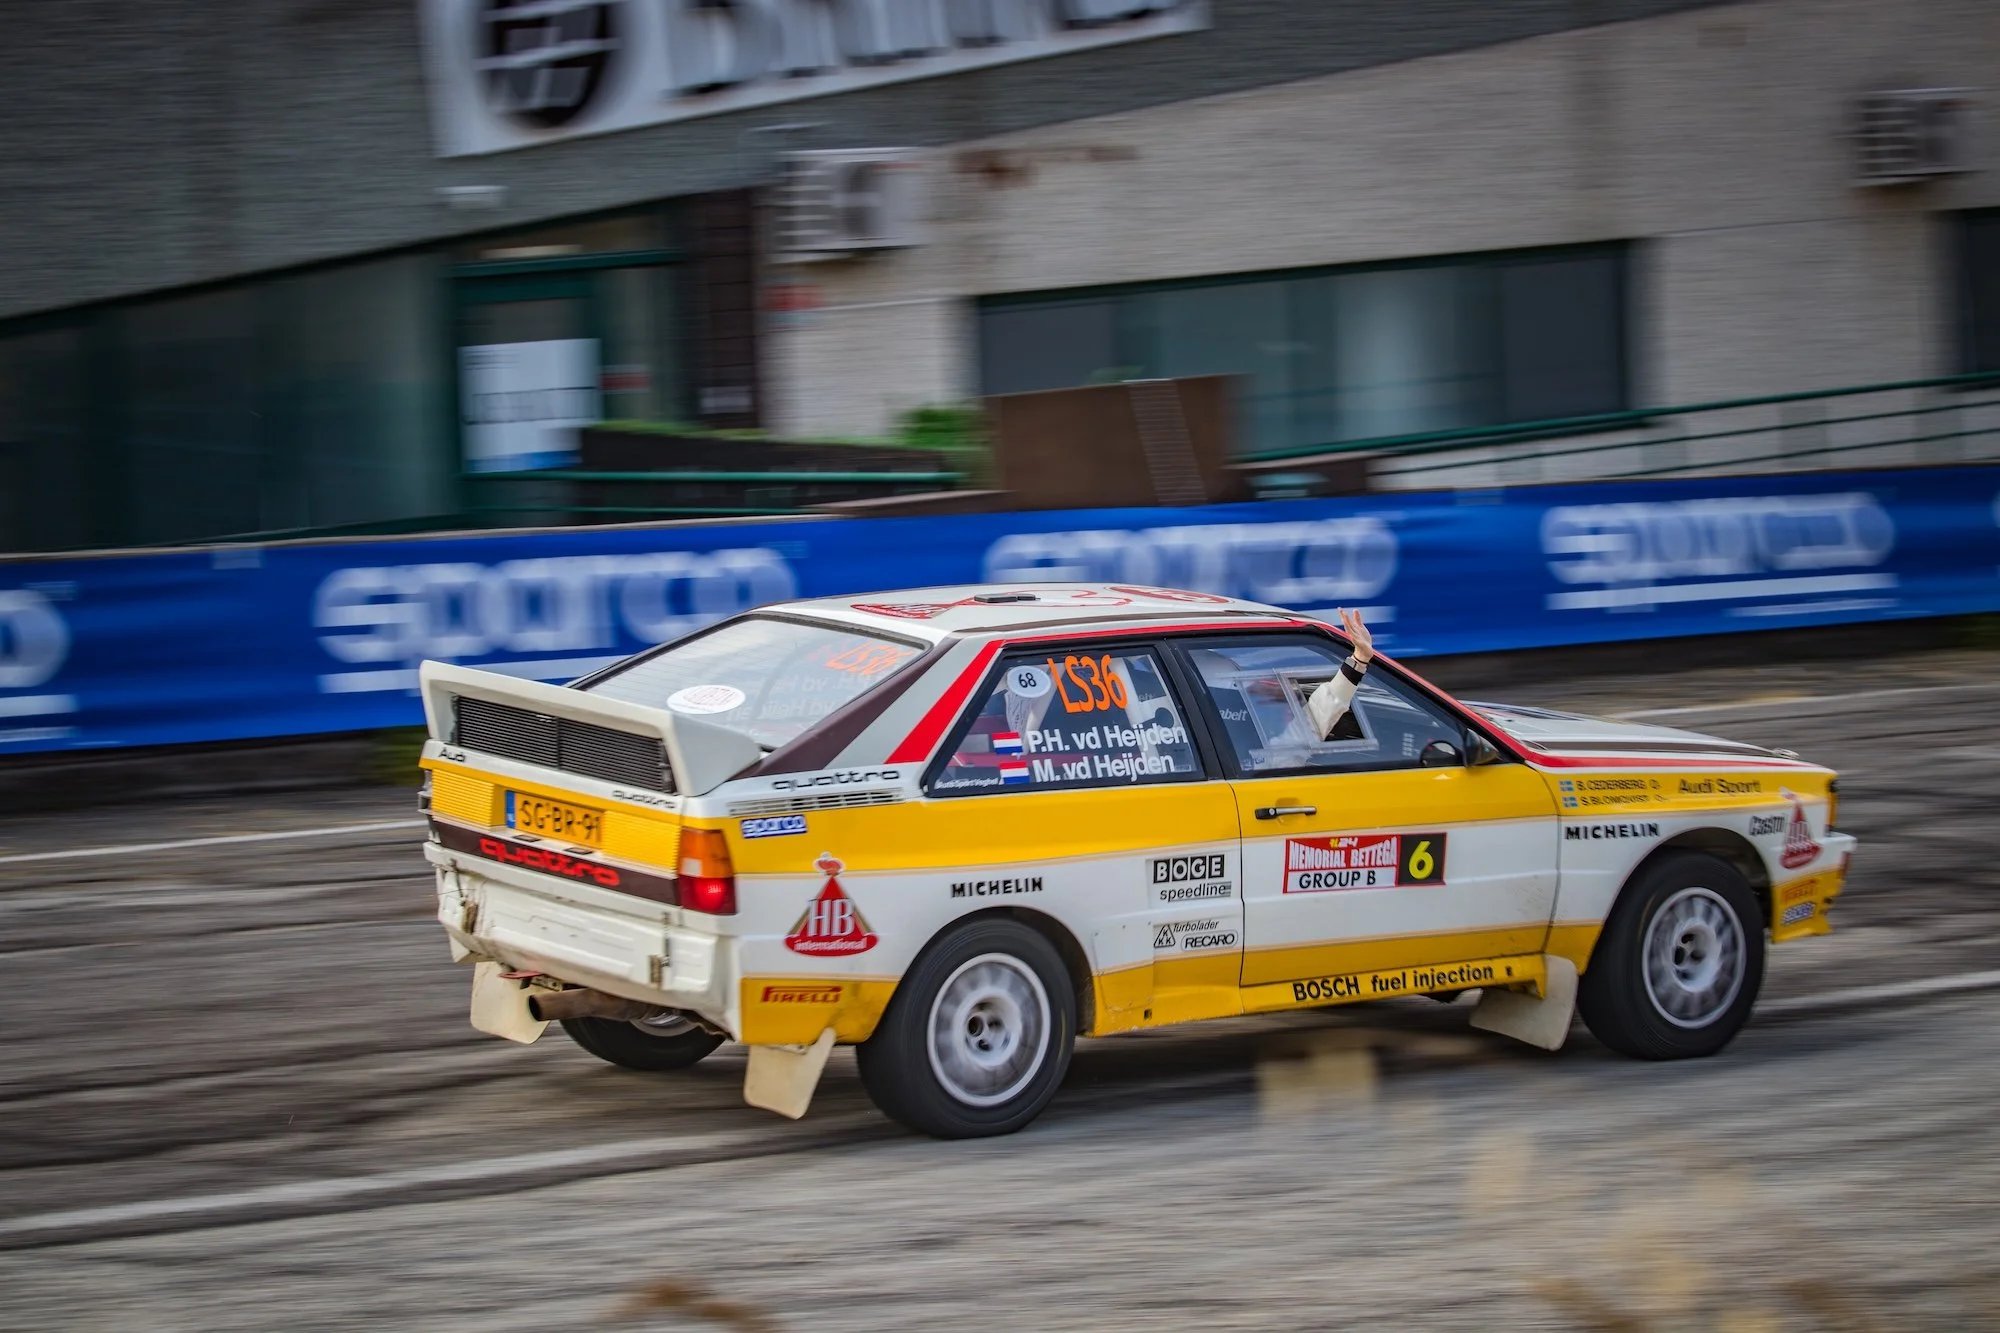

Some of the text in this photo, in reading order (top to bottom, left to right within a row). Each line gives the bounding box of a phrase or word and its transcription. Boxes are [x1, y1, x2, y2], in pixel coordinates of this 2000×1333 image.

[1018, 672, 1036, 688] 68
[1047, 654, 1129, 714] LS36
[1026, 722, 1187, 757] P.H. vd Heijden
[439, 746, 466, 763] Audi
[1033, 753, 1176, 784] M. vd Heijden
[772, 769, 900, 793] quattro
[1678, 777, 1761, 797] Audi Sport
[611, 789, 677, 810] quattro
[742, 815, 805, 837] sparco
[1565, 822, 1661, 841] MICHELIN
[479, 837, 621, 887] quattro
[1288, 836, 1397, 870] MEMORIAL BETTEGA
[1408, 840, 1435, 881] 6
[1154, 854, 1225, 884] BOGE
[1298, 870, 1377, 890] GROUP B
[950, 876, 1044, 898] MICHELIN
[1159, 882, 1228, 902] speedline
[806, 897, 856, 938] HB
[1172, 919, 1220, 933] Turbolader
[1184, 932, 1236, 949] RECARO
[761, 984, 845, 1004] PIRELLI
[1293, 975, 1362, 1003] BOSCH
[1371, 970, 1408, 993] fuel
[1413, 963, 1495, 991] injection
